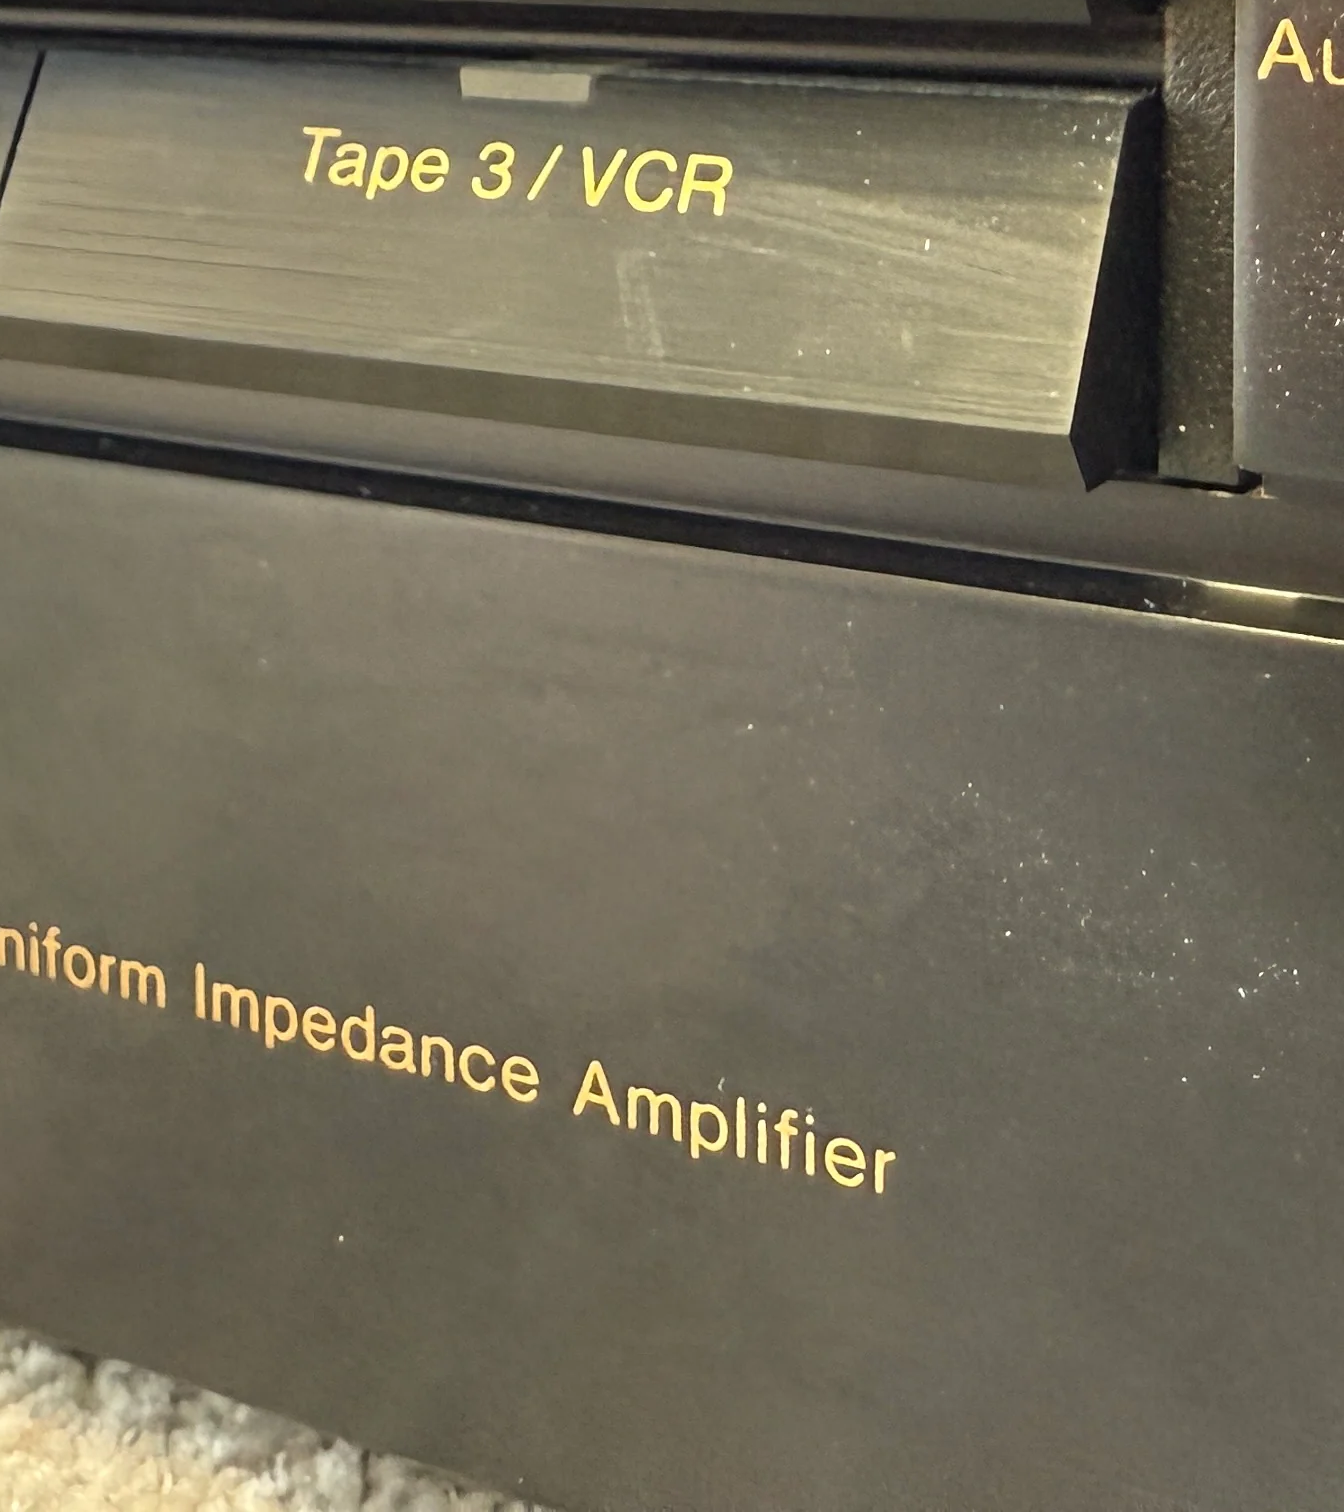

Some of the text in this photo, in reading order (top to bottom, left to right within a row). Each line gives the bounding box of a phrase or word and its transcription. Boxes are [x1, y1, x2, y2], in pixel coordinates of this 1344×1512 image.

[302, 126, 451, 201] Tape
[470, 140, 517, 201] 3
[580, 145, 735, 217] VCR
[193, 962, 541, 1104] Impedance
[572, 1059, 898, 1195] Amplifier
